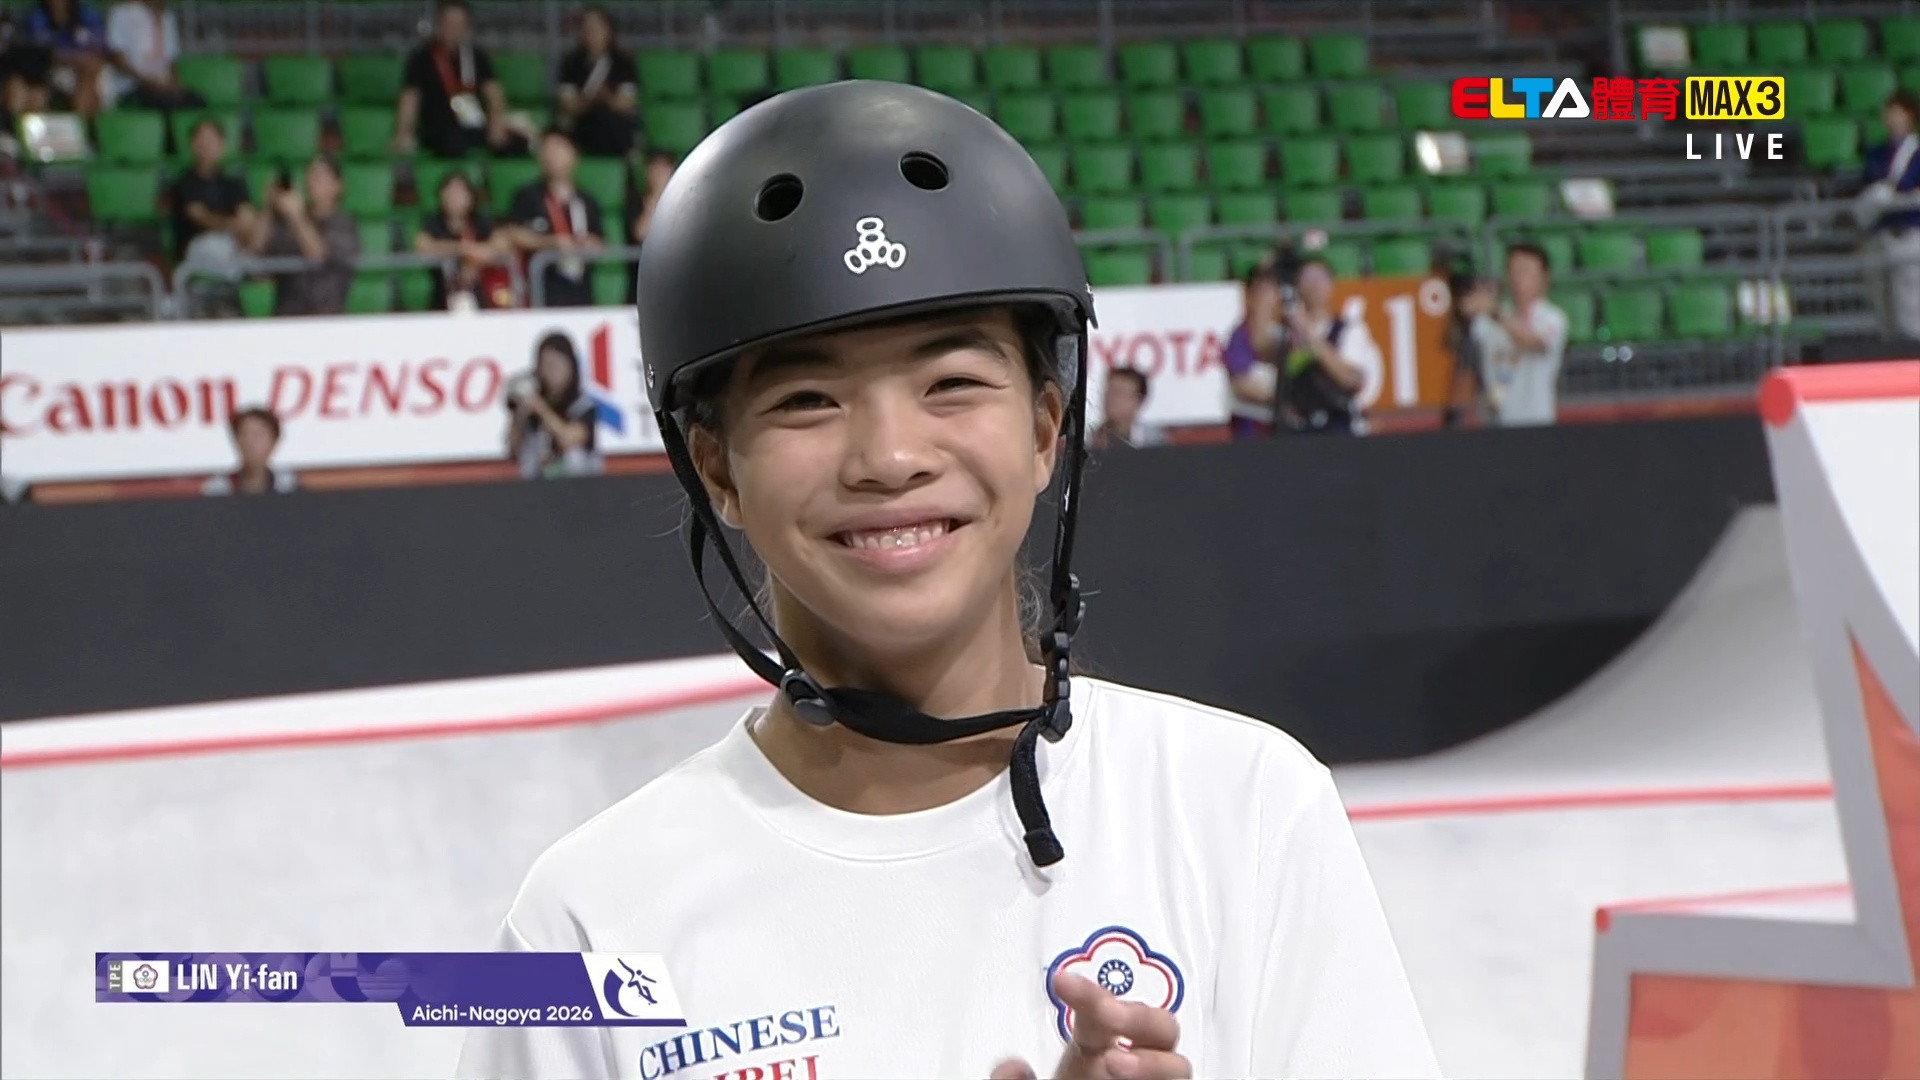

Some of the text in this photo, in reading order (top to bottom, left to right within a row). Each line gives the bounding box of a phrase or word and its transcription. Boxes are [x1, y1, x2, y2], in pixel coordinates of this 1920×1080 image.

[1087, 331, 1223, 377] YOTA
[0, 373, 238, 437] Canon
[267, 356, 503, 422] DENSO
[639, 1005, 840, 1080] CHINESE
